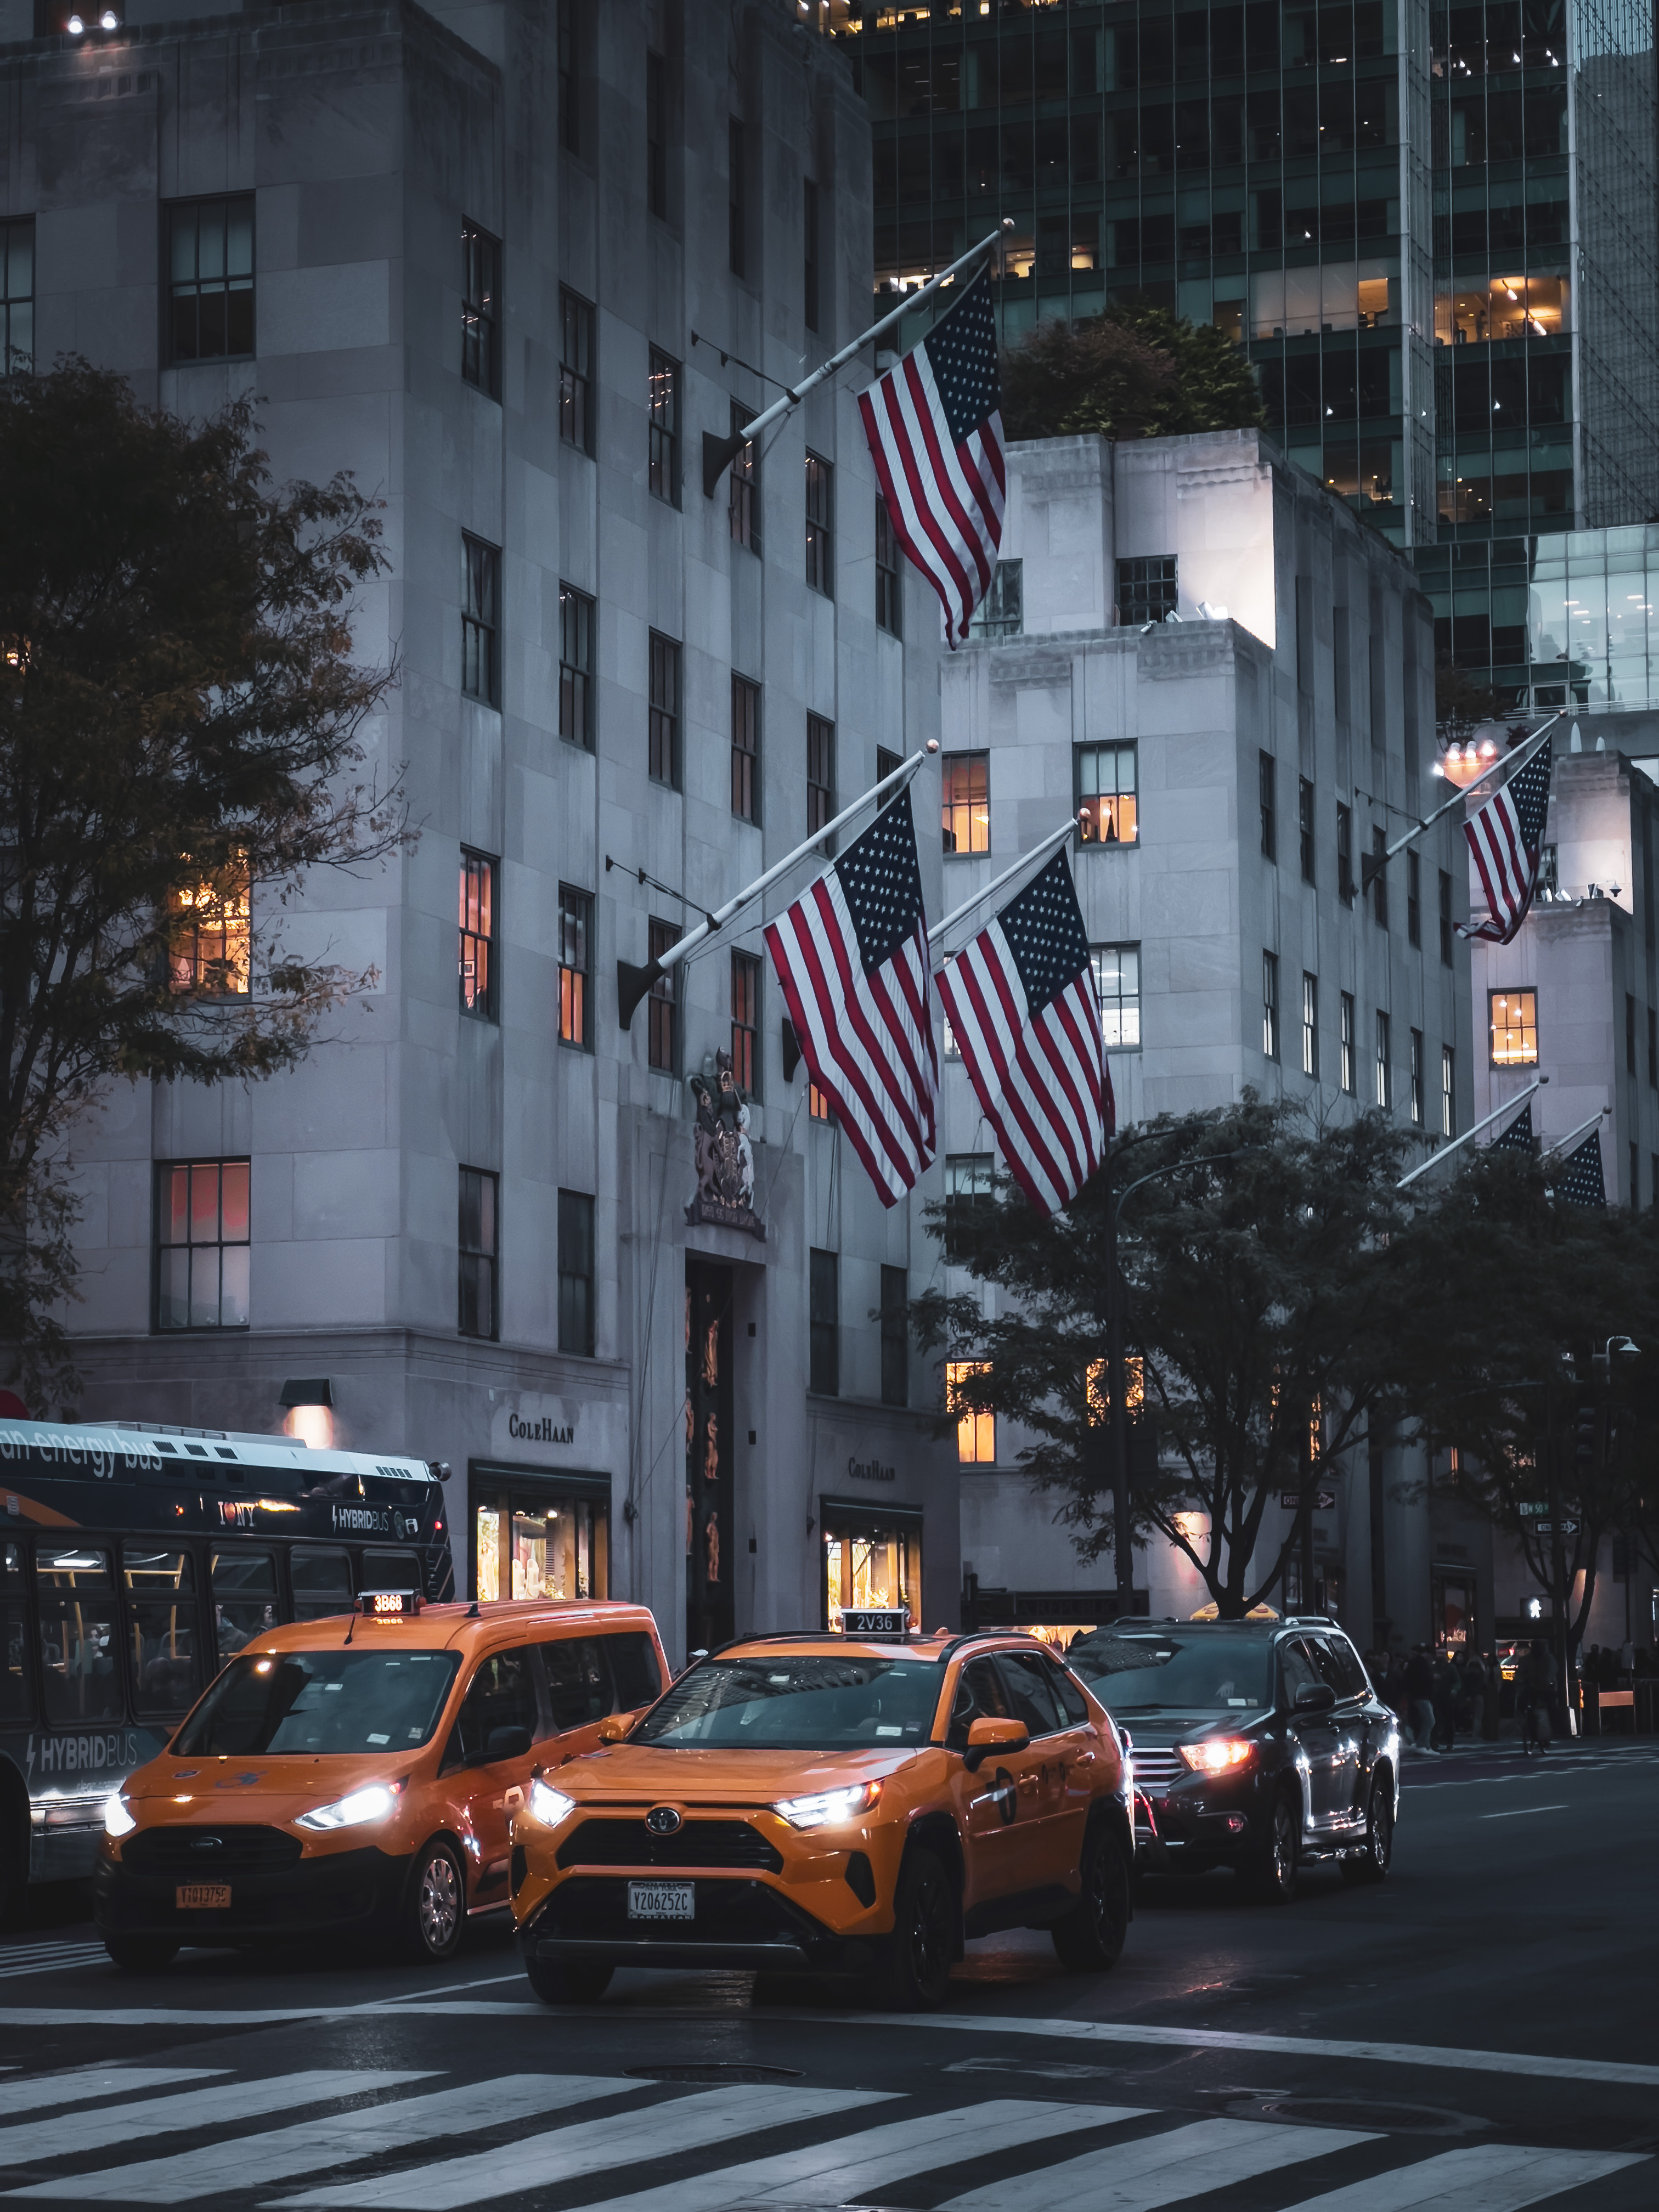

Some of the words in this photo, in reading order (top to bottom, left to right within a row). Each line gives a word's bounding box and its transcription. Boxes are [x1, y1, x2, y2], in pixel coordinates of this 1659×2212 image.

[112, 1431, 163, 1471] bus
[375, 1594, 403, 1612] 3B68
[857, 1615, 893, 1630] 2V36
[634, 1892, 687, 1910] Y206252C
